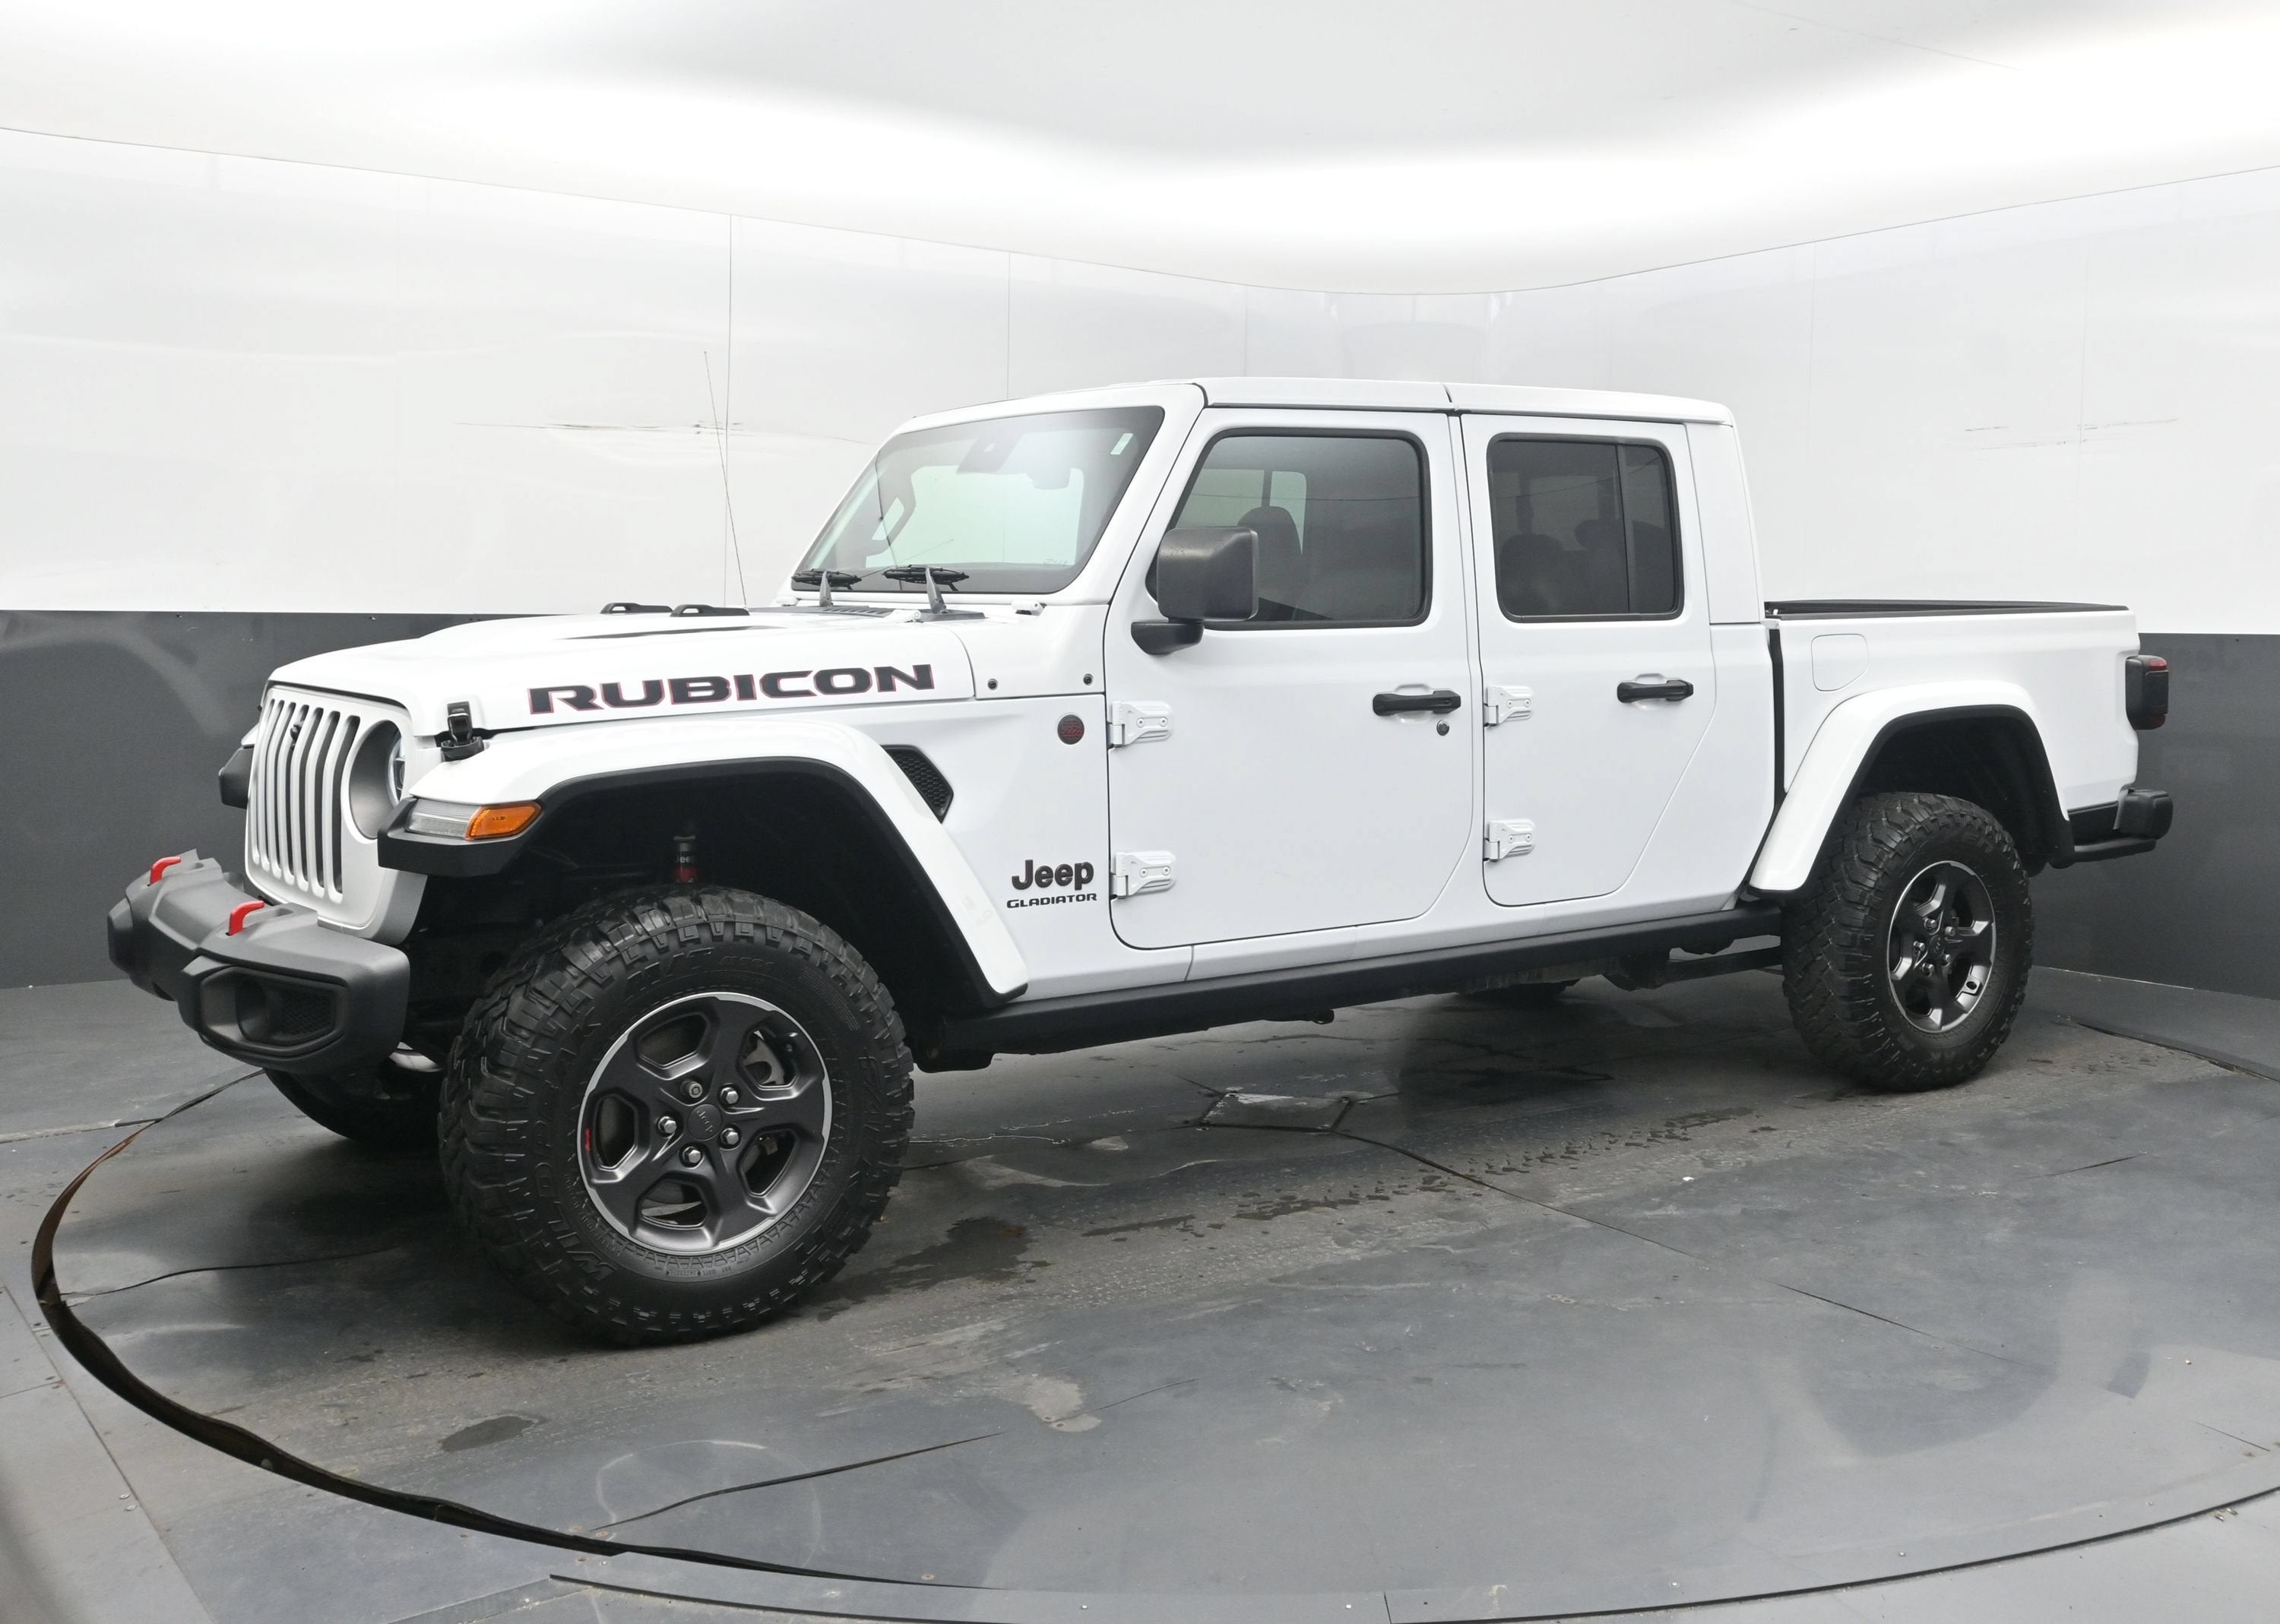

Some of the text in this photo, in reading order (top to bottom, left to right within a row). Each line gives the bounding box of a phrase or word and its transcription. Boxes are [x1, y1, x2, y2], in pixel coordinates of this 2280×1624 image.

[527, 663, 936, 715] RUBICON
[676, 854, 693, 864] Jee
[1012, 859, 1094, 891] Jeep
[1006, 893, 1097, 909] GLADIATOR
